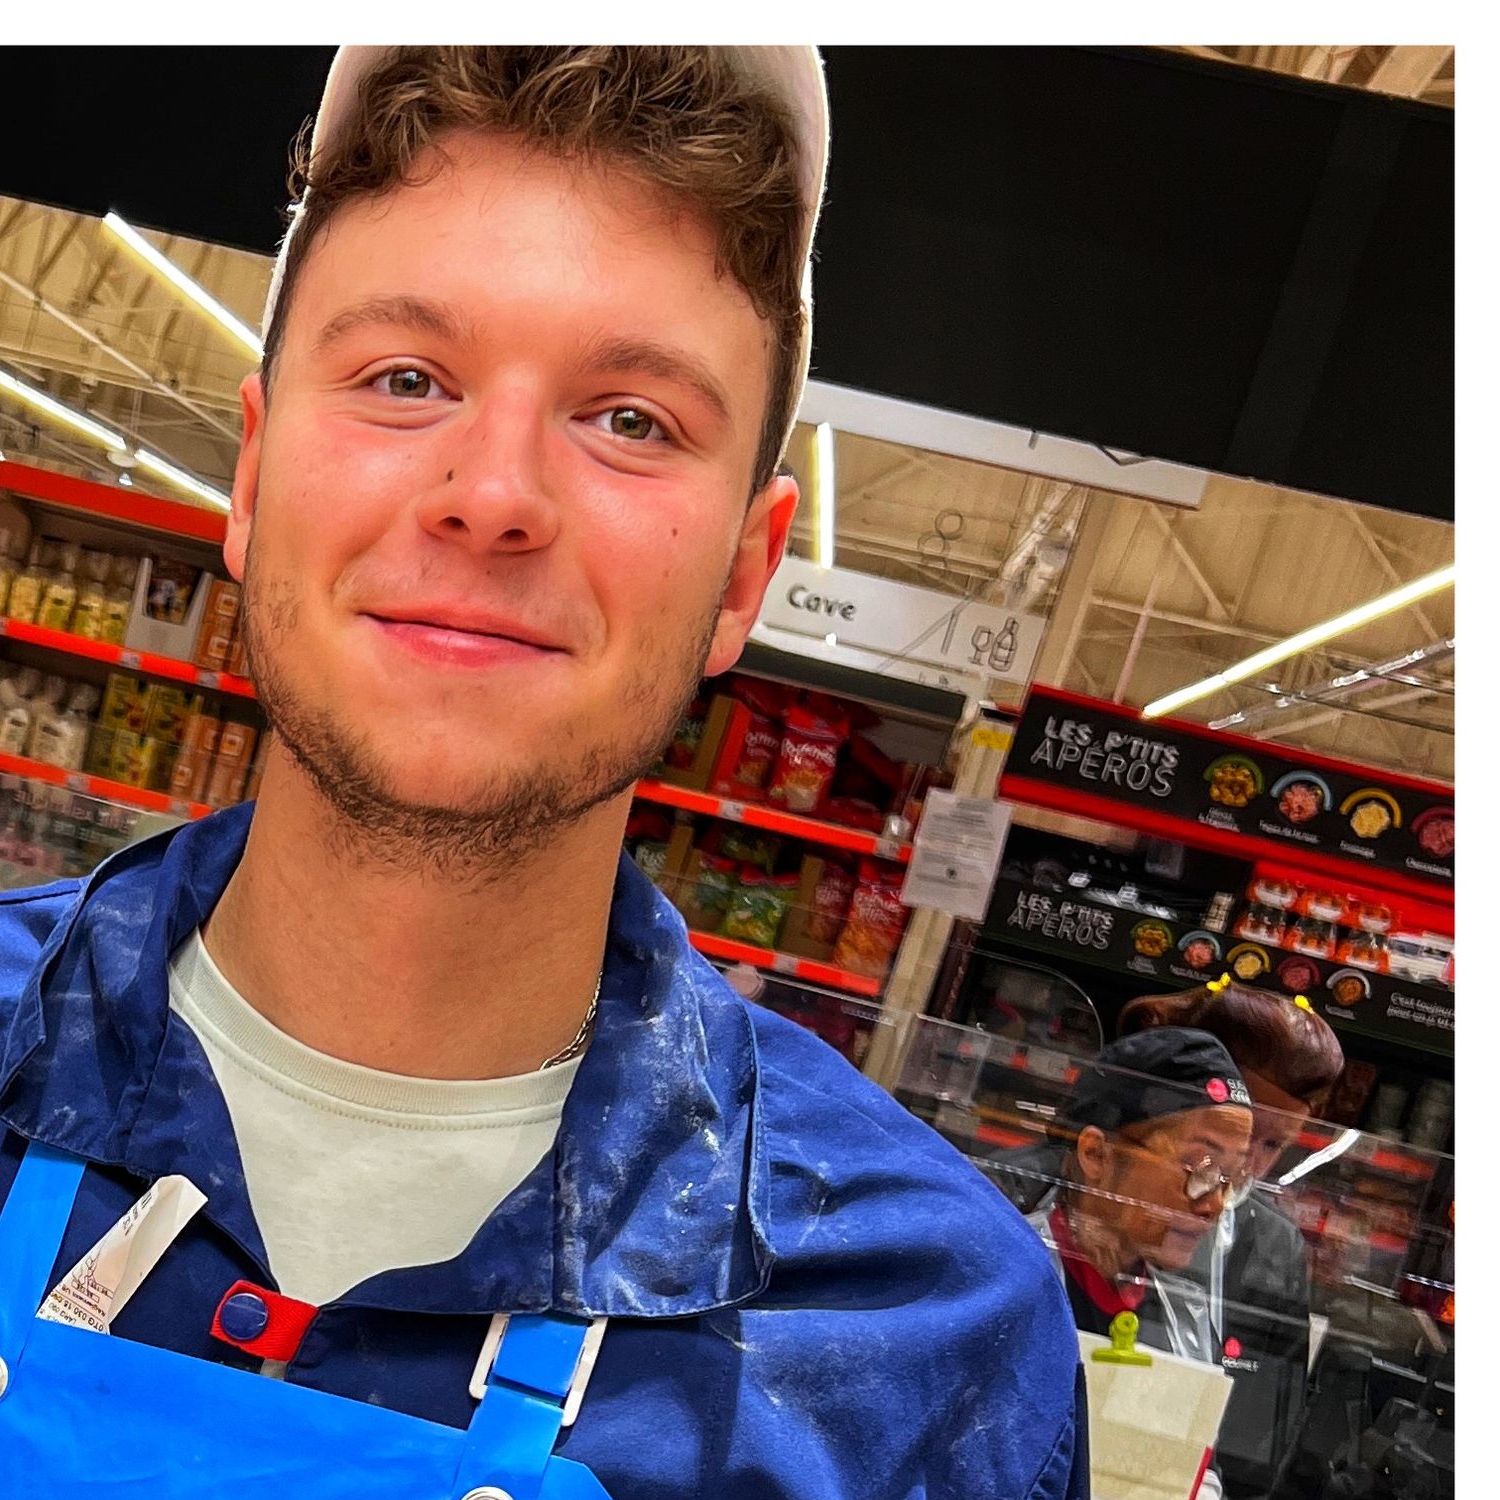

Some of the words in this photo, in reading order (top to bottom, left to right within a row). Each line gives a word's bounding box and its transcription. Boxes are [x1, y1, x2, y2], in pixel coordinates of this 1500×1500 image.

[786, 583, 858, 622] Cave
[1044, 716, 1092, 745] LES
[1104, 730, 1180, 769] P'TITS
[1030, 738, 1179, 798] APÉROS
[1017, 889, 1053, 913] LES
